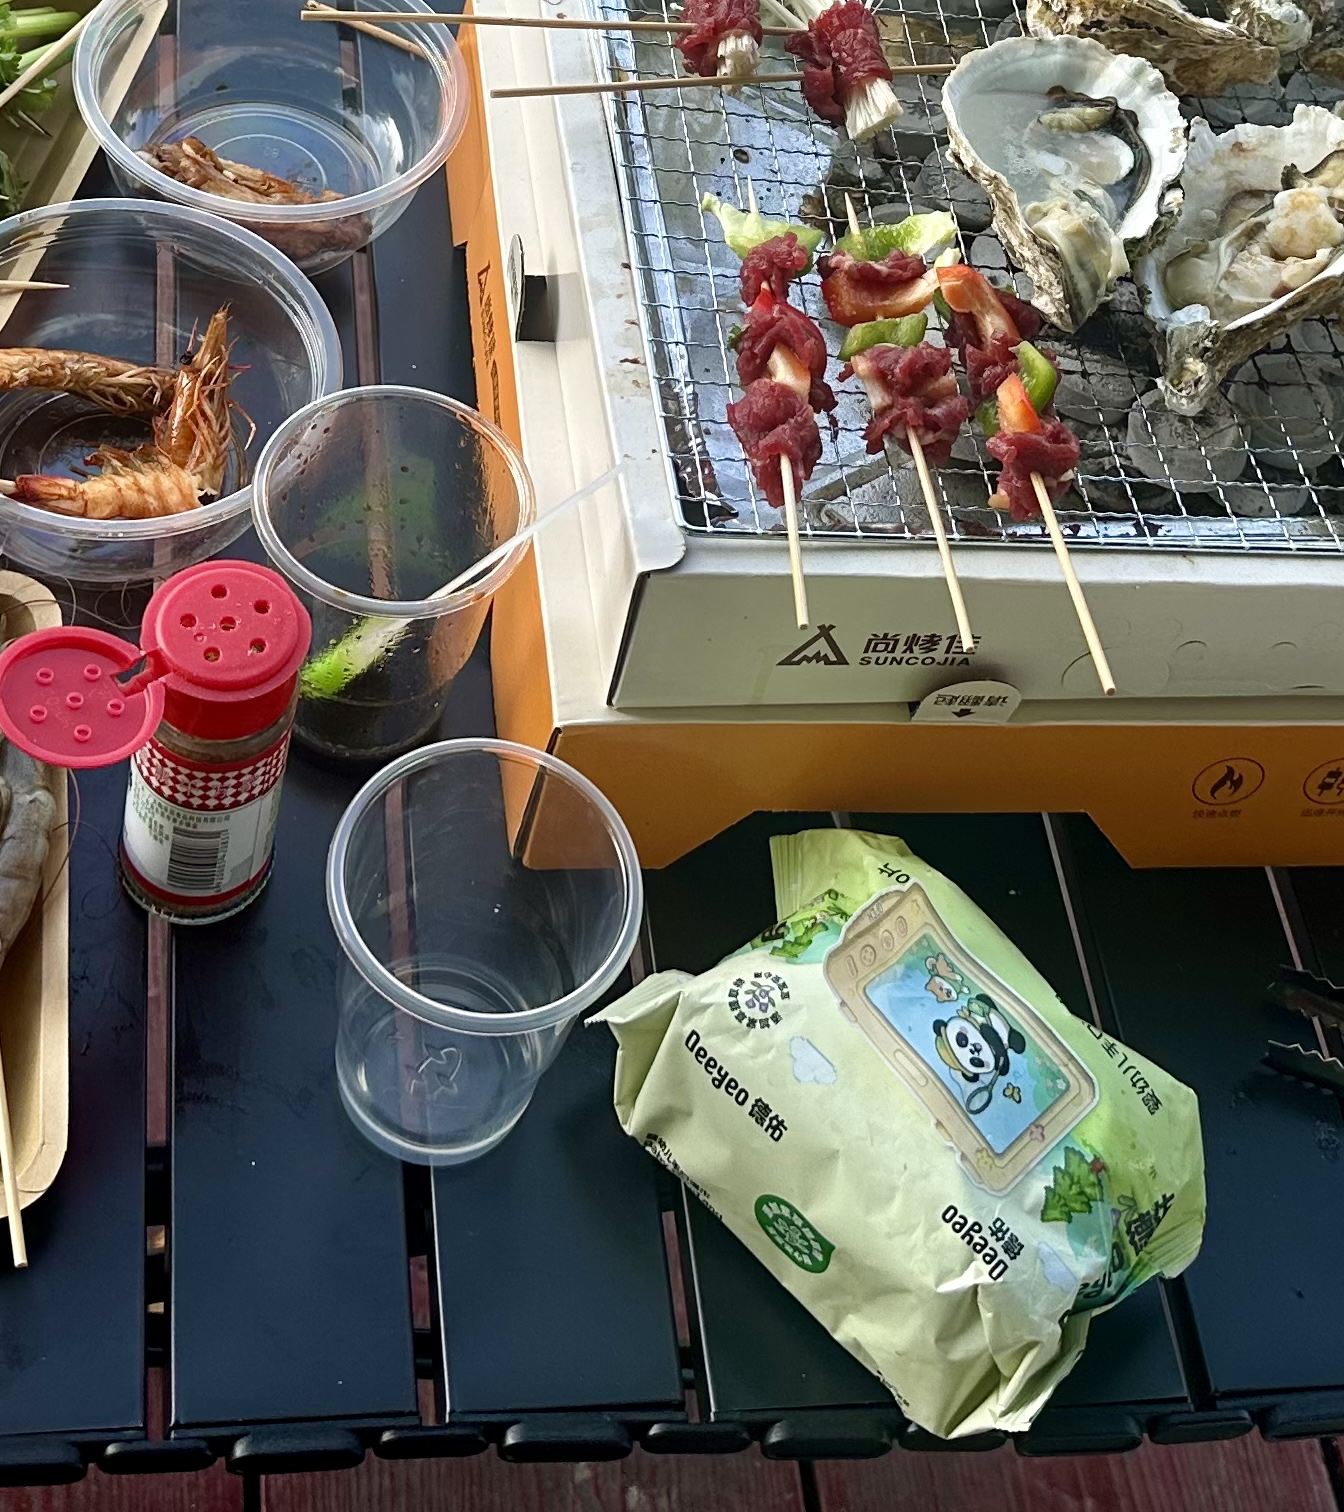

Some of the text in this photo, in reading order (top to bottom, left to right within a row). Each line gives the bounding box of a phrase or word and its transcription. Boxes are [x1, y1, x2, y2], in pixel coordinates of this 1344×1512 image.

[858, 656, 971, 667] SUNCOJIA
[685, 1029, 788, 1142] Deeyeo 德佑
[1082, 1020, 1163, 1116] 婴幼儿手口
[941, 1204, 1009, 1281] Deeyeo
[987, 1217, 1025, 1261] 德佑
